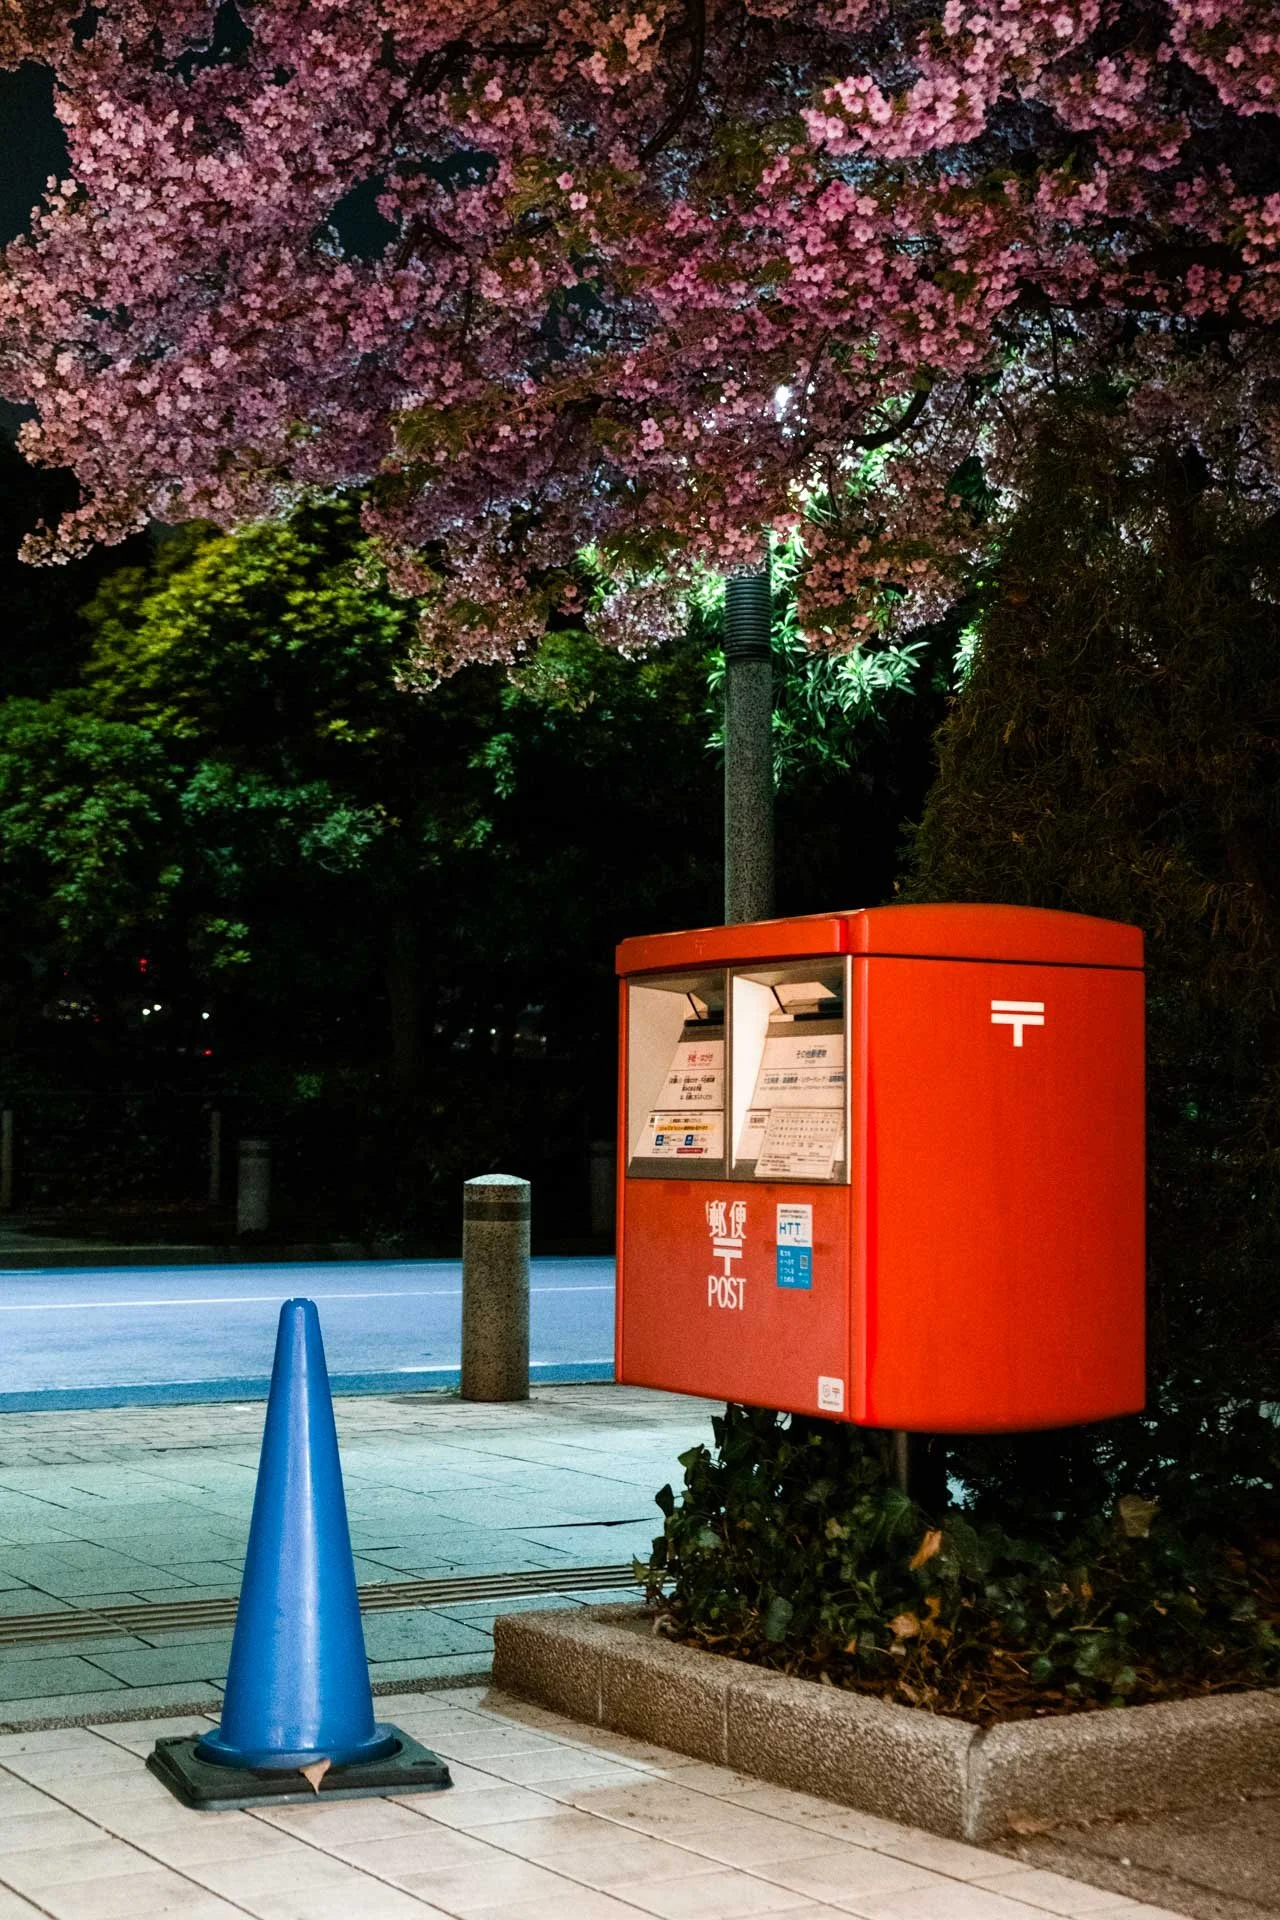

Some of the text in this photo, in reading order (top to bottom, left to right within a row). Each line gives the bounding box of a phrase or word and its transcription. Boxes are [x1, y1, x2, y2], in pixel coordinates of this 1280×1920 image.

[705, 1200, 747, 1239] 郵便
[779, 1222, 801, 1235] HTT
[708, 1275, 747, 1310] POST
